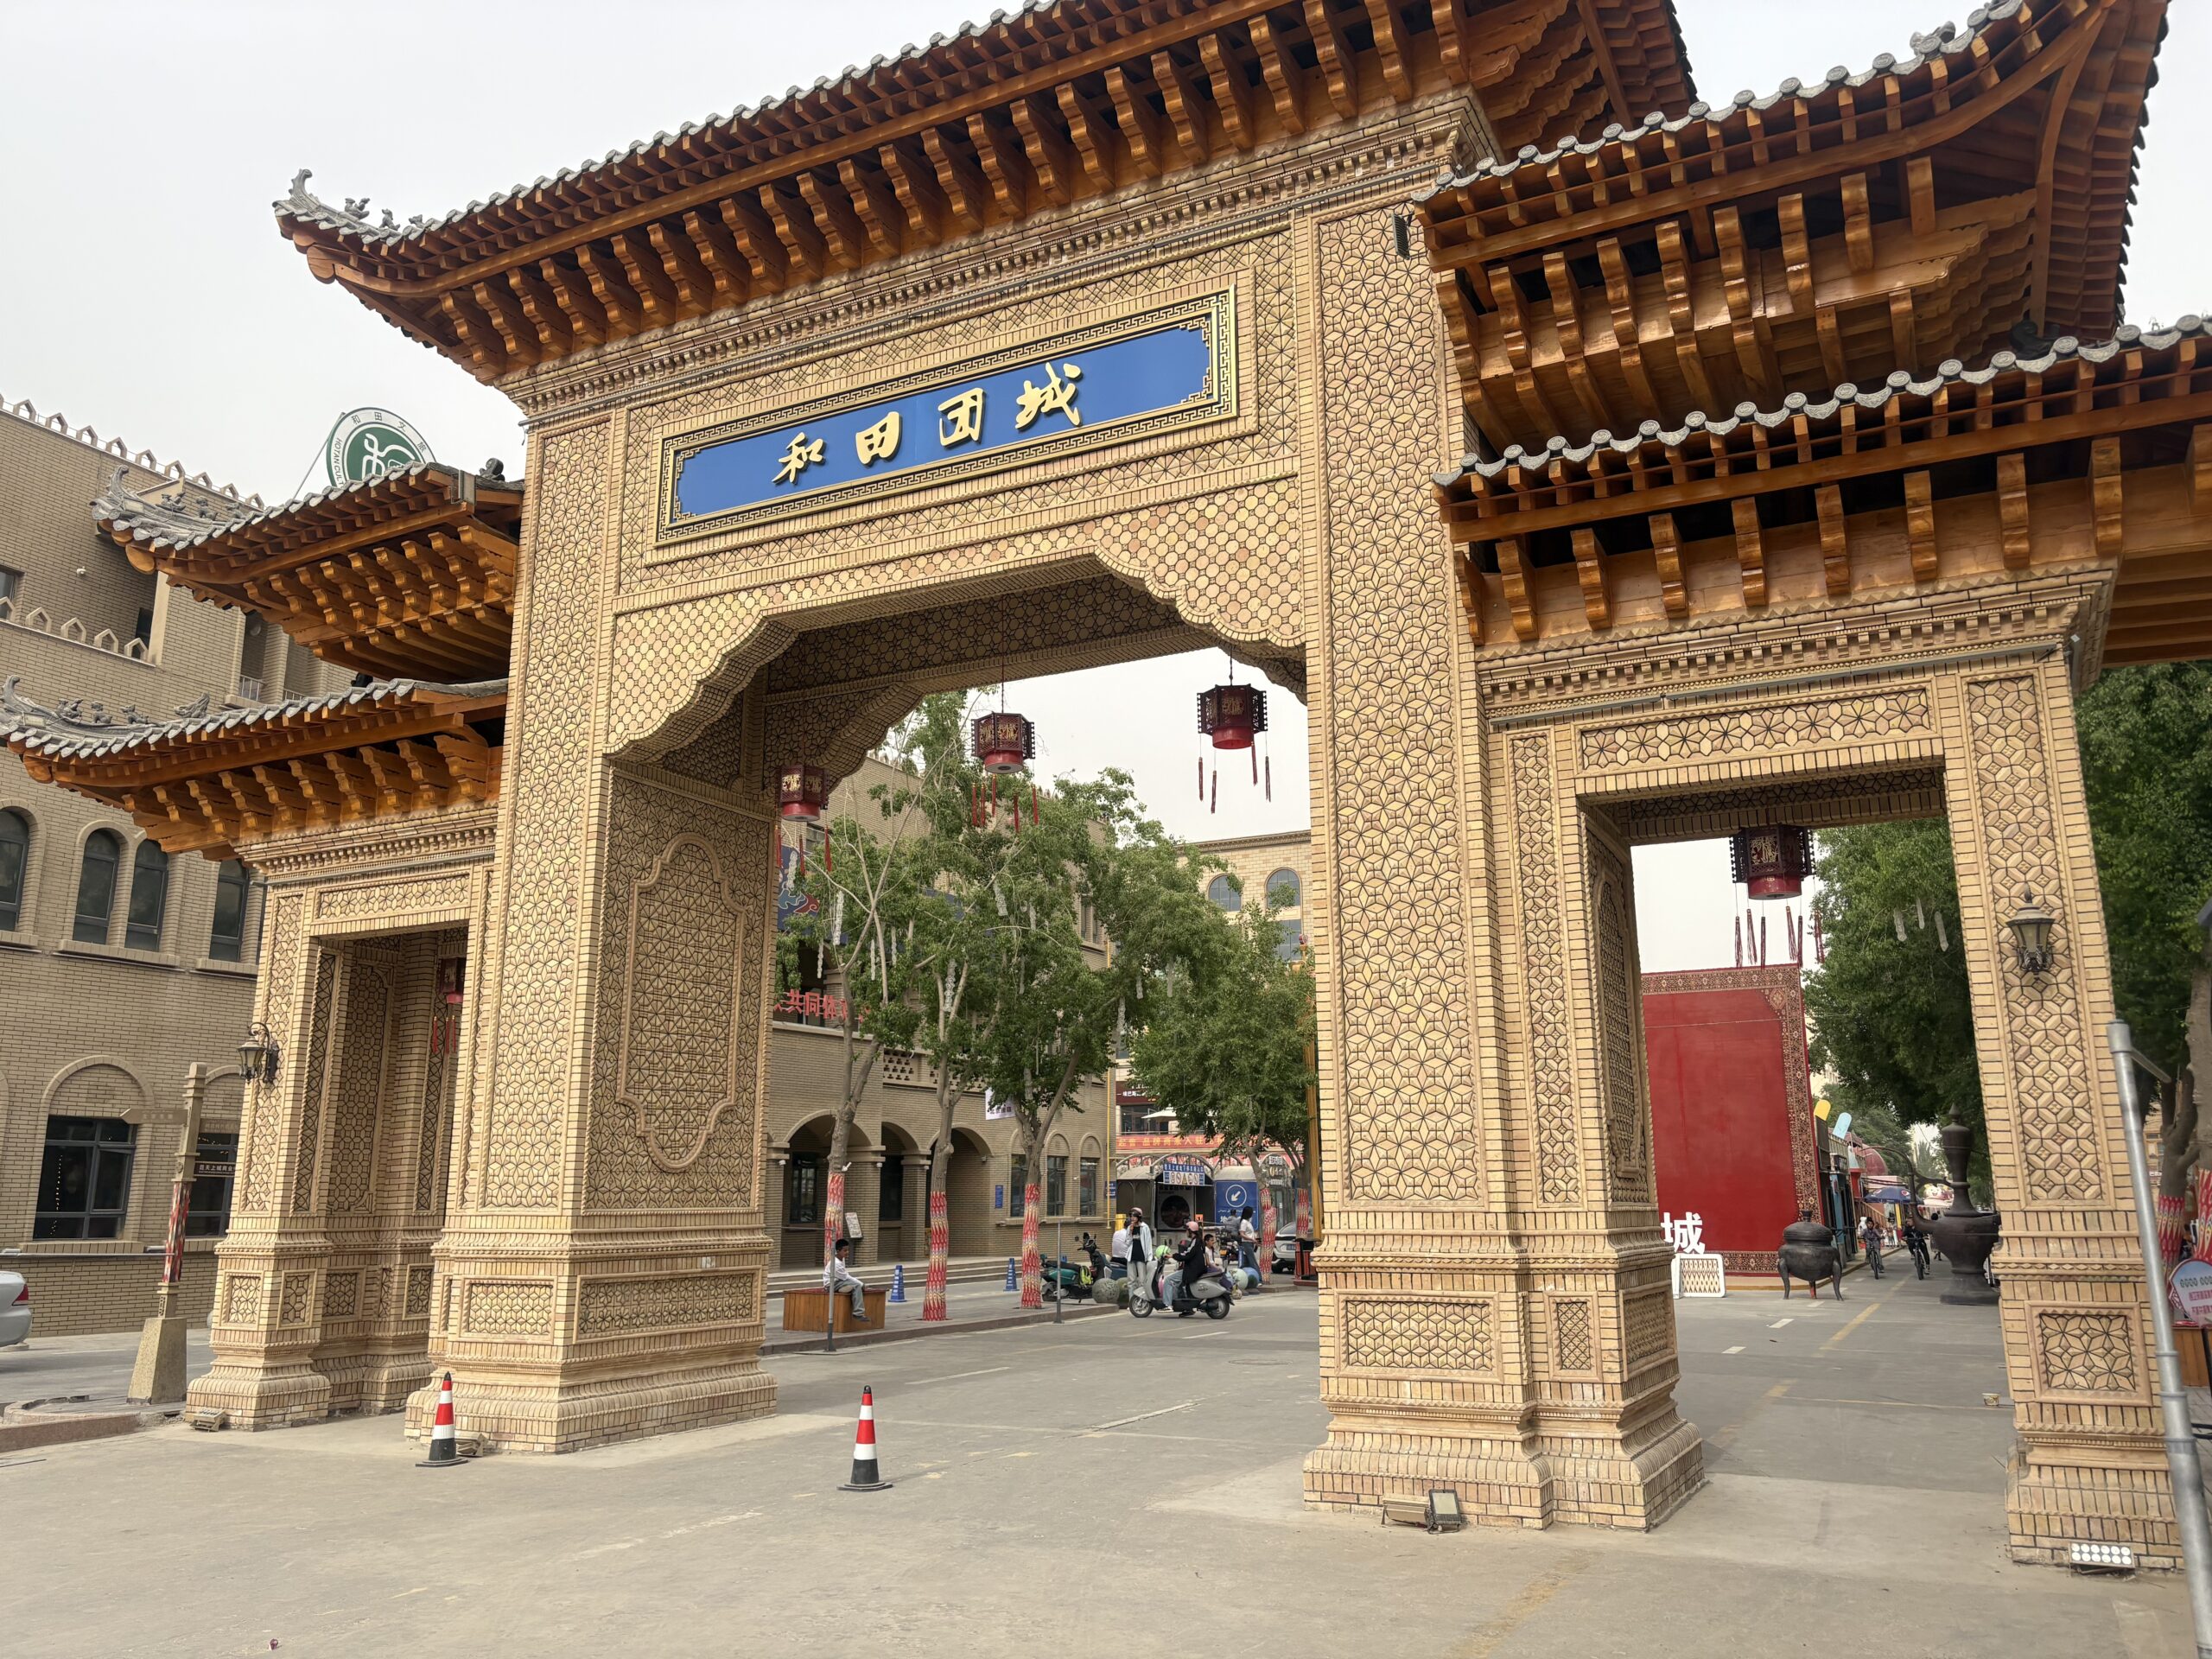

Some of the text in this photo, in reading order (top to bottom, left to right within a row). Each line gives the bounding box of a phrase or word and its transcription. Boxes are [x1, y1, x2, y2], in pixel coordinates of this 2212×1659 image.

[351, 411, 427, 452] 和田文旅
[772, 362, 1084, 485] 和田团城
[333, 437, 343, 465] HOTAN
[1661, 1211, 1706, 1254] 城
